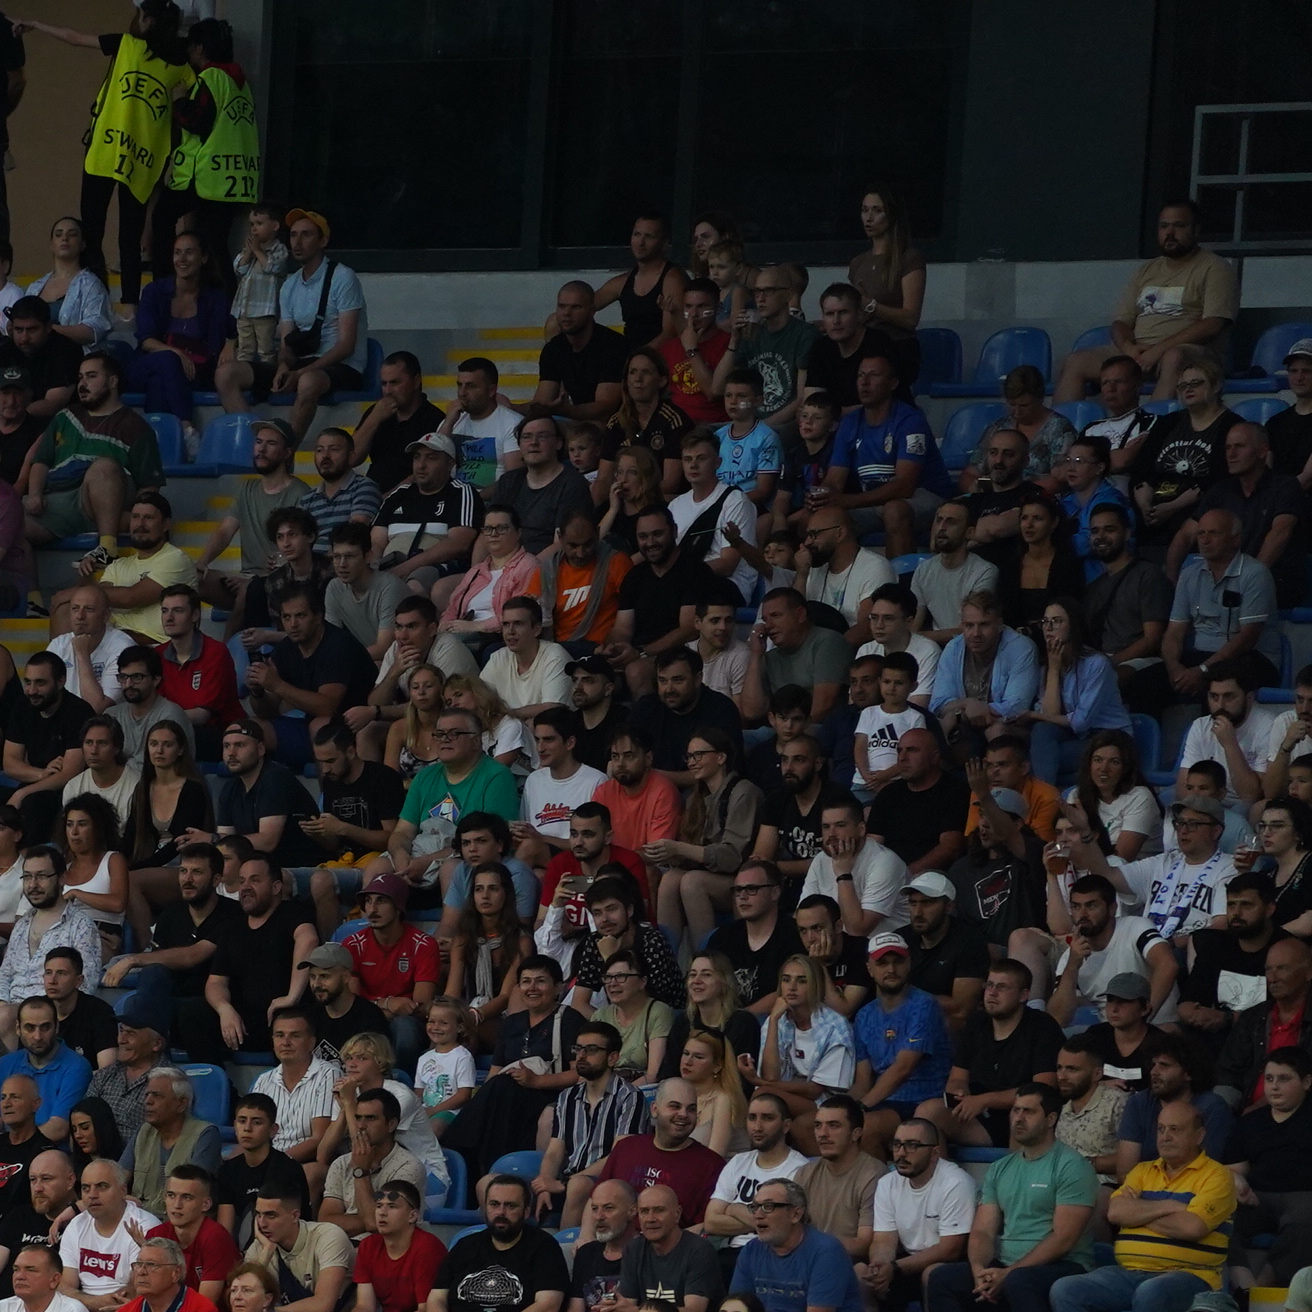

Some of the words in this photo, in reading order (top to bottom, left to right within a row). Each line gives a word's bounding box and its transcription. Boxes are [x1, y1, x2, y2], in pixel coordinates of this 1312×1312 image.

[120, 78, 167, 119] UEFA
[227, 100, 255, 124] UFA
[869, 737, 898, 749] adida
[83, 1255, 115, 1271] Levi's
